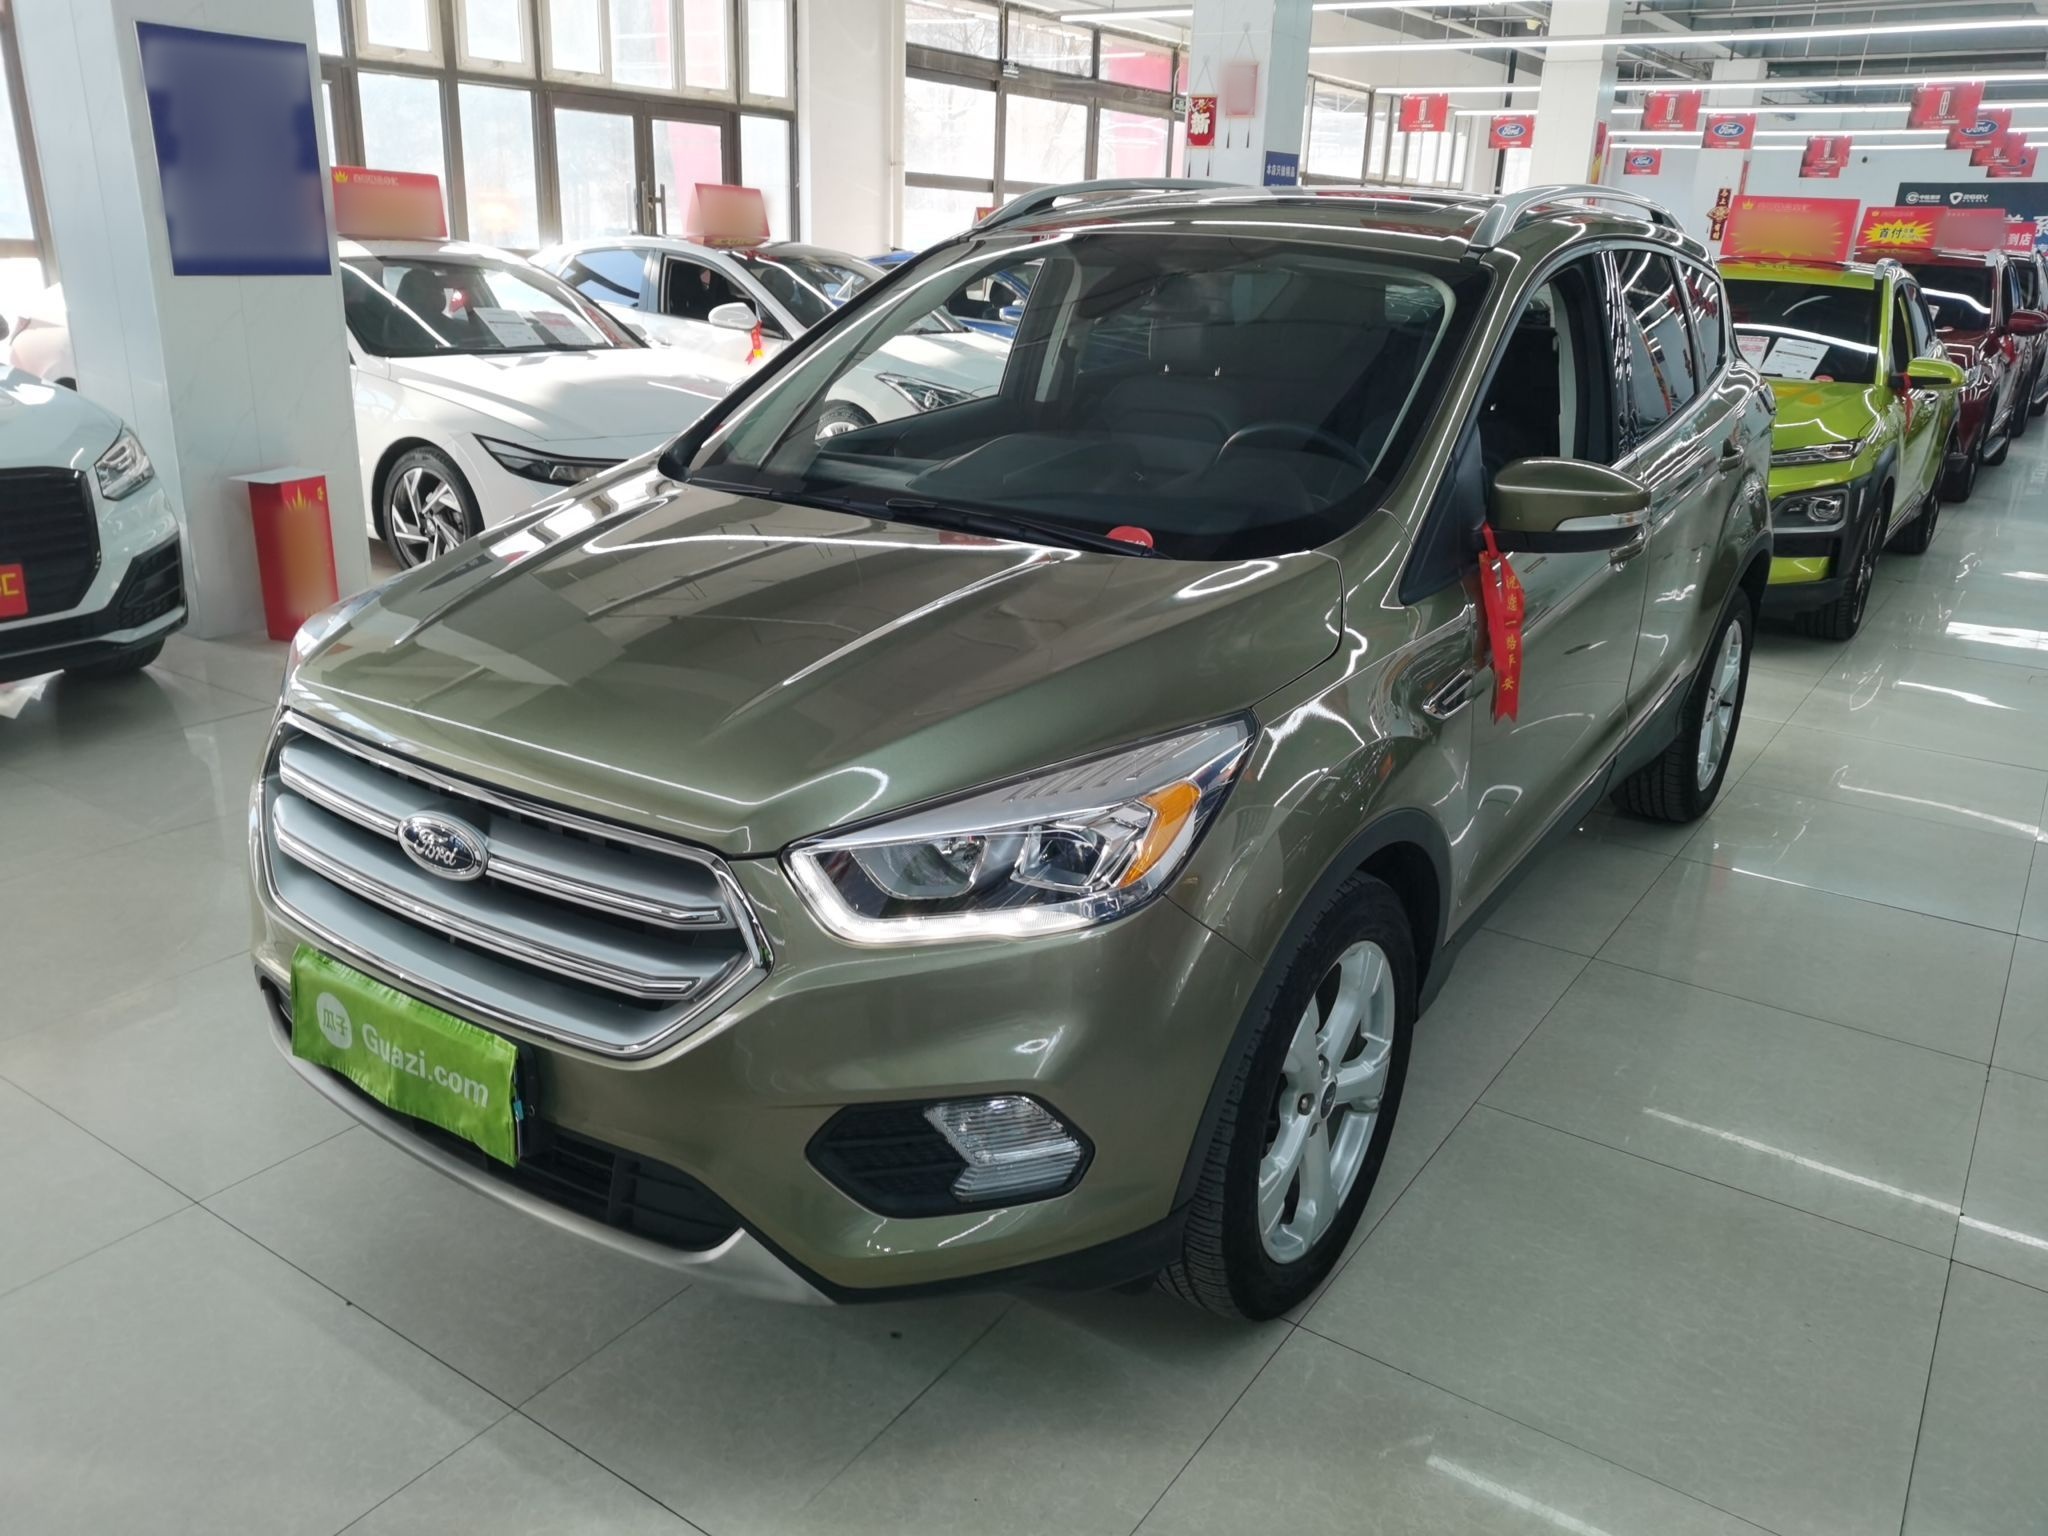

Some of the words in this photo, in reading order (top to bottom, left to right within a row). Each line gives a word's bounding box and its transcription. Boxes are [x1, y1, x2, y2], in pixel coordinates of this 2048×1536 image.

[1190, 112, 1210, 135] 新
[1880, 228, 1902, 239] 首付
[2001, 233, 2032, 247] 到店
[0, 573, 19, 596] C
[413, 829, 458, 866] Ford
[323, 1008, 348, 1038] 瓜子
[362, 1023, 489, 1108] Guazi.com
